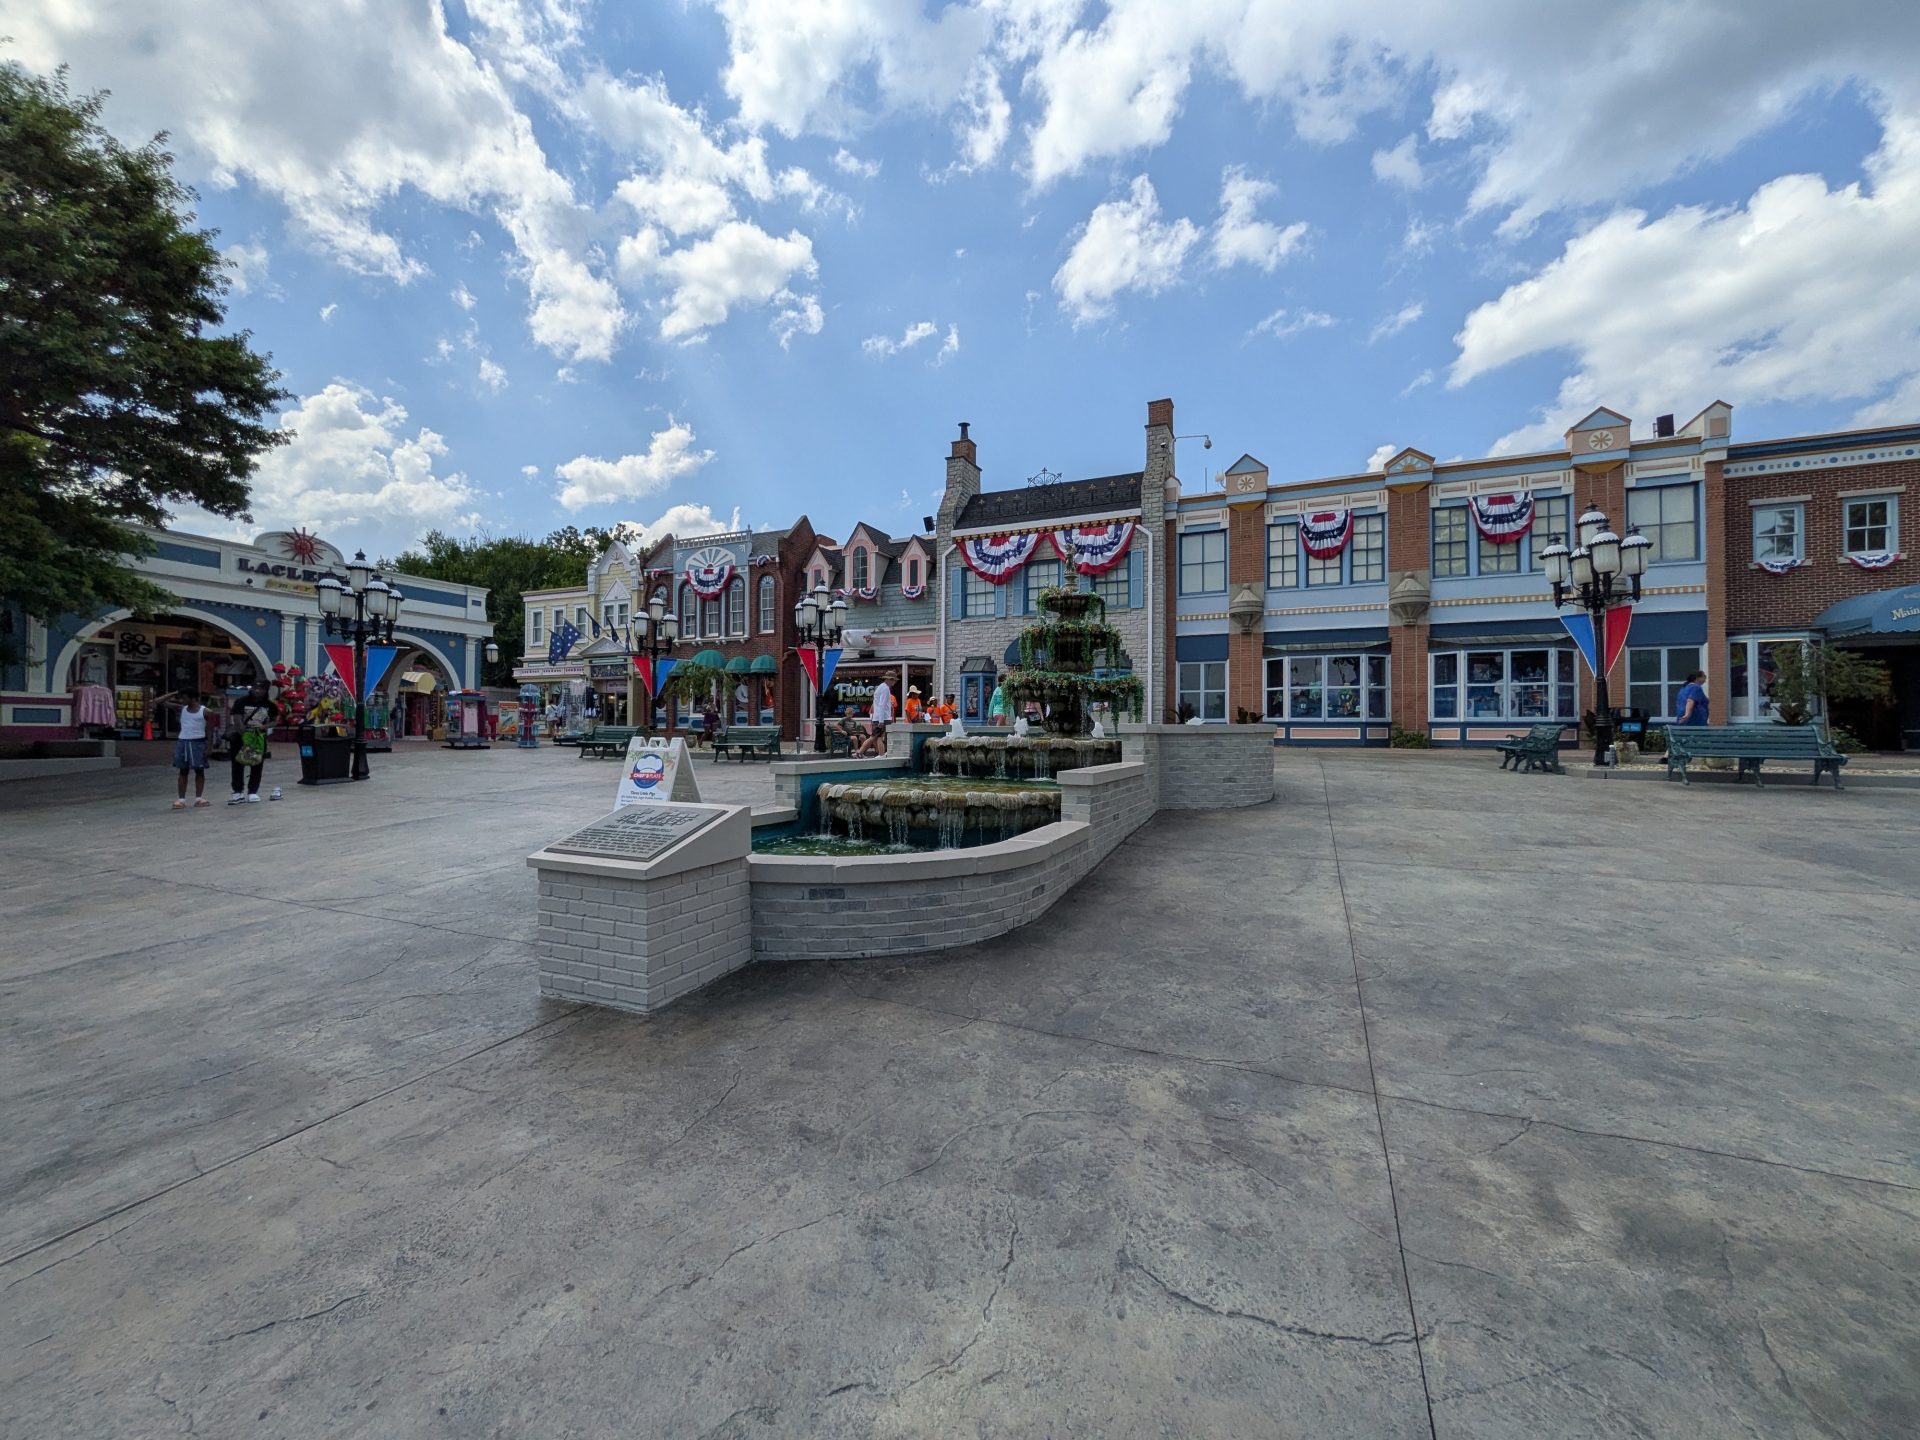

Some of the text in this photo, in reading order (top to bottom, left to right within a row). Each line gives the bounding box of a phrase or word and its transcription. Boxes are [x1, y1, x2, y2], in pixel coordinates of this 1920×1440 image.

[1890, 607, 1920, 620] Main
[120, 632, 146, 643] GO
[119, 641, 152, 655] BIG
[834, 683, 878, 701] FUDG
